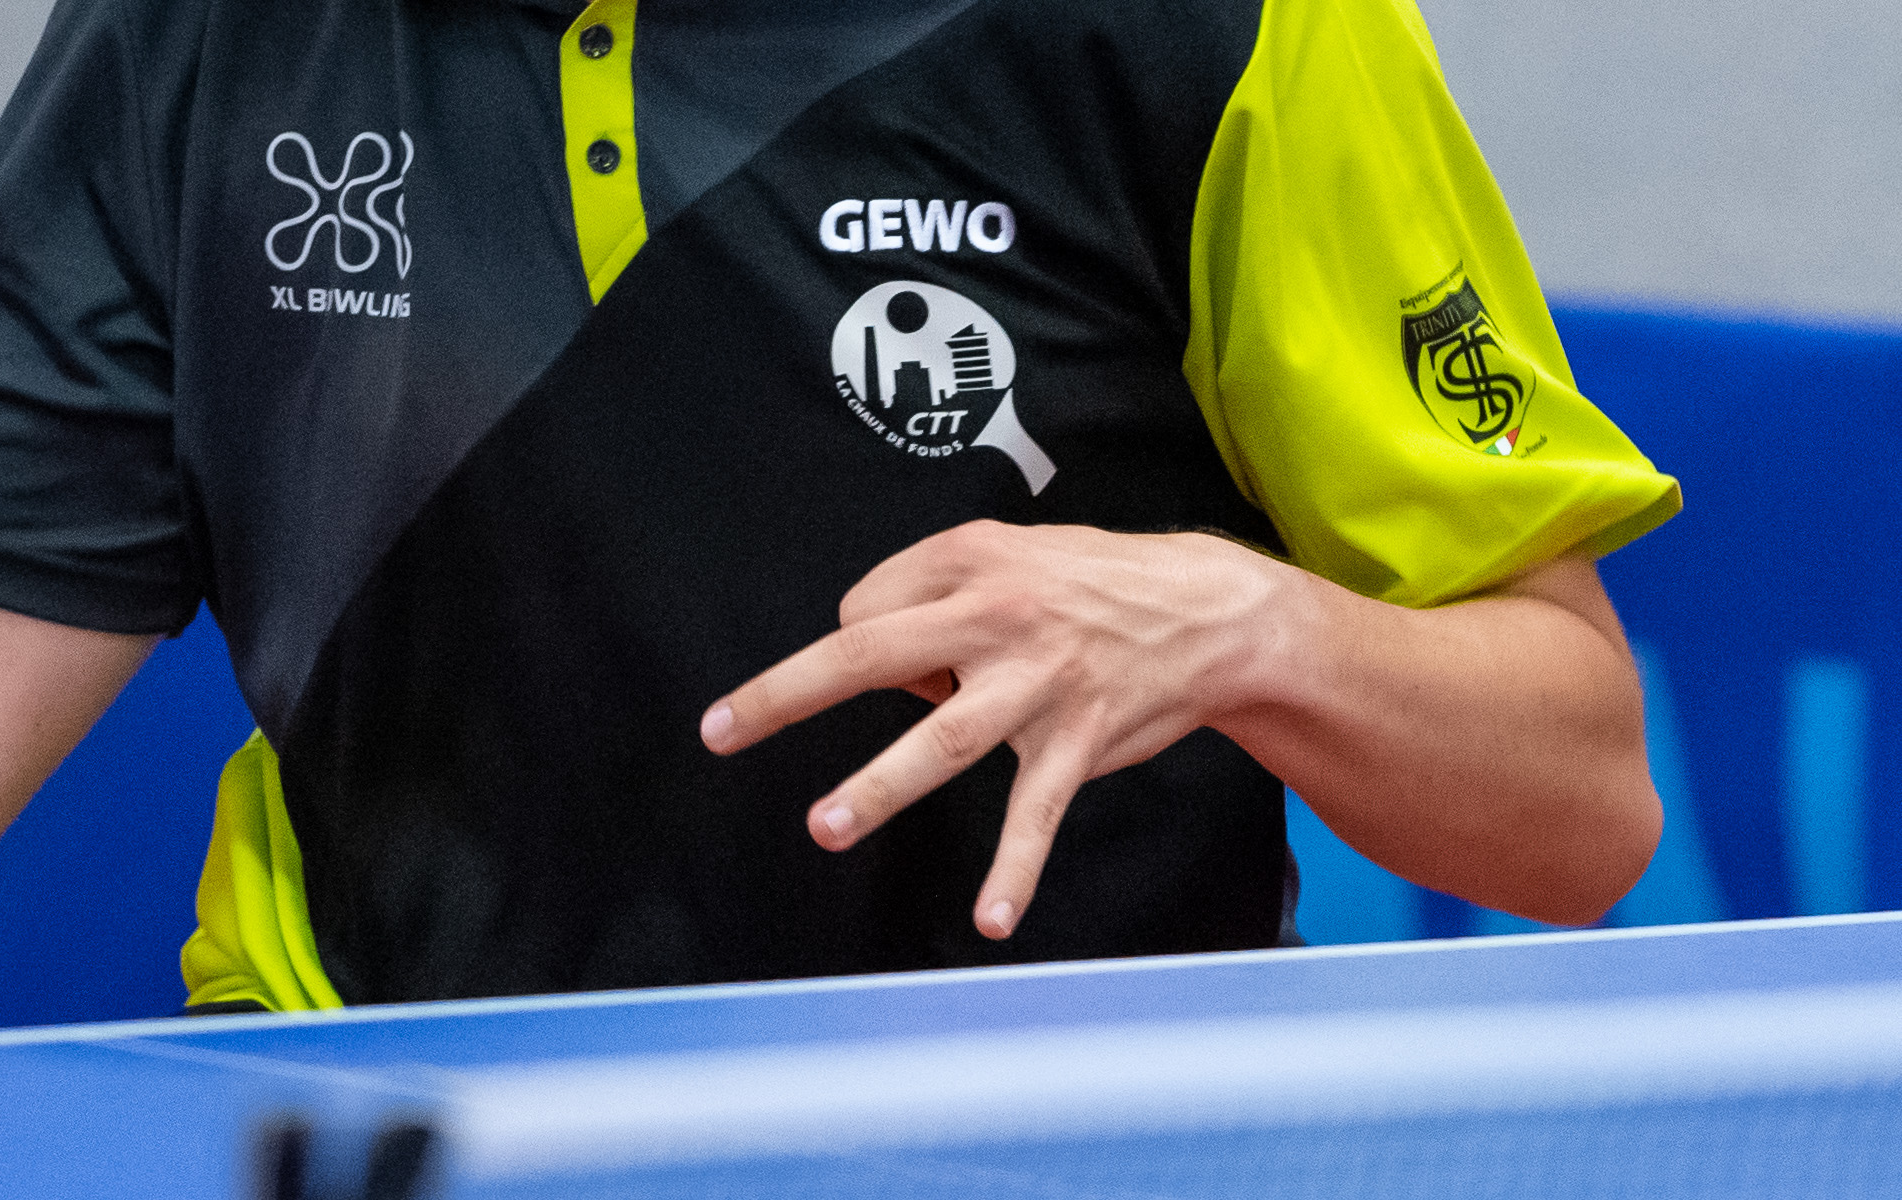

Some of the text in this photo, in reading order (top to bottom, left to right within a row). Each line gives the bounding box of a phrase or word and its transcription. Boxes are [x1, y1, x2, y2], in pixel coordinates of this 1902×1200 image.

[819, 199, 1017, 253] GEWO
[270, 286, 303, 311] XL
[835, 379, 965, 458] LA CHAUX DE FONDS
[906, 410, 969, 437] CTT
